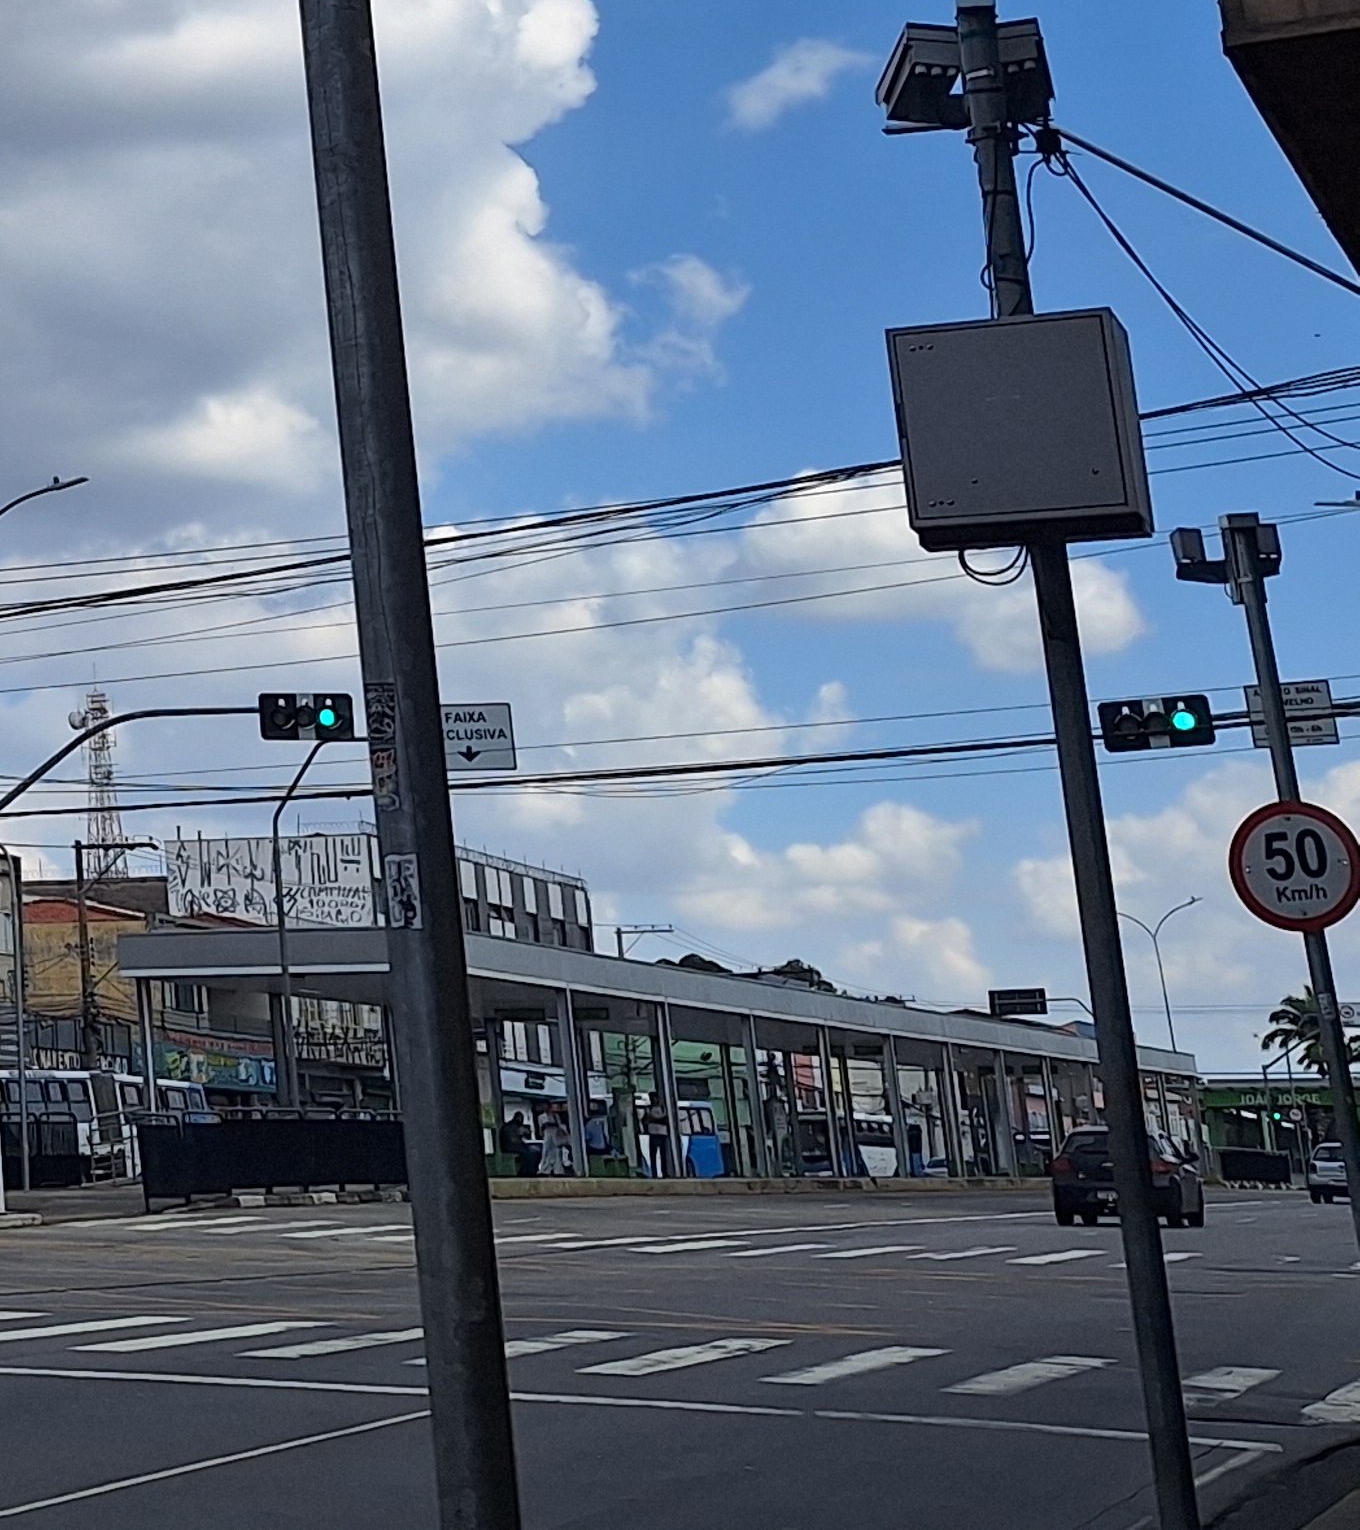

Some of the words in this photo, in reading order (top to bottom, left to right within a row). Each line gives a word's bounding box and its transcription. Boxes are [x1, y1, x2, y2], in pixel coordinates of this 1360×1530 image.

[444, 711, 486, 724] FAIXA
[443, 728, 508, 741] CLUSIVA
[1264, 827, 1328, 882] 50
[1275, 883, 1328, 904] Km/h
